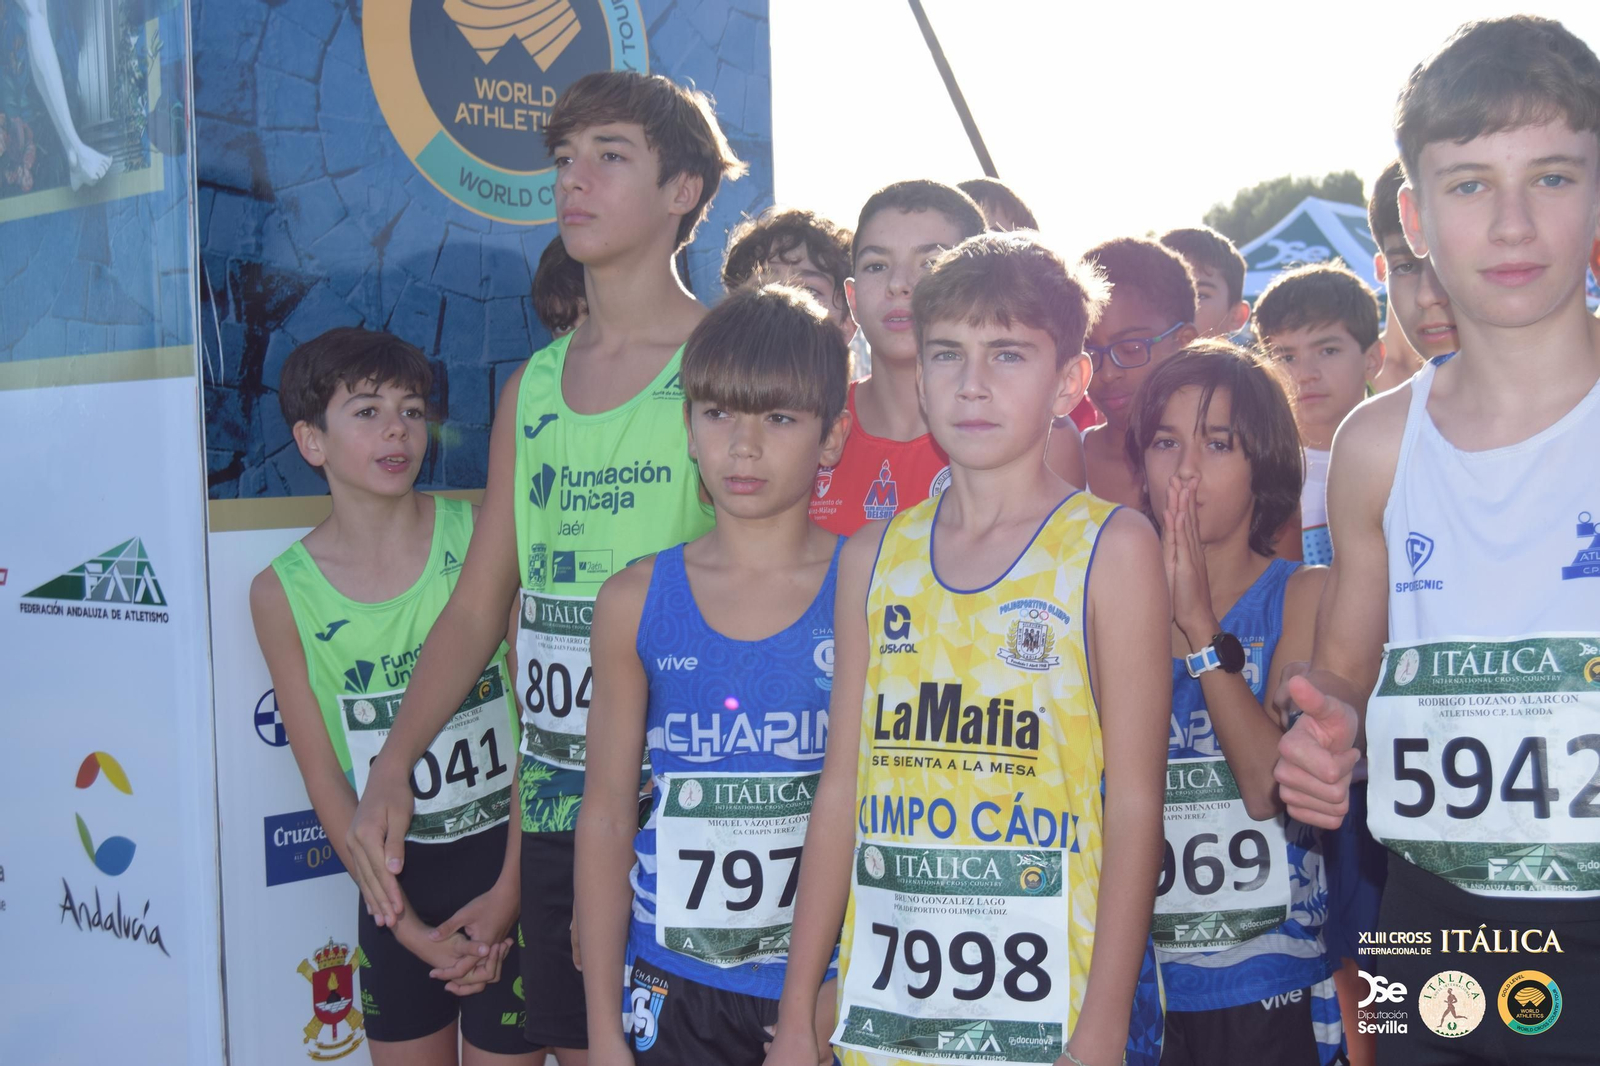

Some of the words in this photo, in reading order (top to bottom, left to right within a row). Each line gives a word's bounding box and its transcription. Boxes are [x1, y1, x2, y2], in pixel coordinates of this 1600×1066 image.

[474, 77, 557, 107] WORLD
[457, 167, 532, 208] WORLD
[560, 460, 672, 488] Fundación
[560, 486, 635, 515] Unicaja
[557, 520, 585, 536] Jaén
[20, 600, 64, 616] FEDERACIÓN
[66, 607, 109, 620] ANDALUZA
[111, 609, 122, 620] DE
[124, 610, 170, 624] ATLETISMO
[1000, 599, 1048, 615] POLIDEPORTIVO
[1048, 604, 1071, 625] OLIMPO
[656, 654, 699, 671] vive
[1432, 643, 1563, 677] ITÁLICA
[1432, 677, 1492, 685] INTERNATIONAL
[1494, 675, 1520, 683] CROSS
[1522, 674, 1562, 682] COUNTRY
[1418, 697, 1466, 707] RODRIGO
[1469, 695, 1517, 706] LOZANO
[1519, 694, 1579, 705] ALARCON
[1439, 708, 1491, 717] ATLETISMO
[1492, 708, 1509, 717] C.P.
[1511, 708, 1523, 716] LA
[1525, 707, 1553, 716] RODA
[370, 728, 507, 800] 041
[872, 756, 889, 766] SE
[893, 756, 943, 769] SIENTA
[947, 759, 957, 770] A
[963, 760, 984, 772] LA
[990, 763, 1037, 777] MESA
[1393, 733, 1600, 820] 5942
[715, 778, 813, 804] ITÁLICA
[1184, 802, 1231, 812] MENACHO
[1184, 812, 1206, 820] JEREZ
[708, 819, 743, 827] MIGUEL
[744, 814, 787, 827] VÁZQUEZ
[773, 826, 796, 834] JEREZ
[894, 851, 1002, 880] ITÁLICA
[678, 845, 804, 912] 797
[1470, 883, 1513, 891] ANDALUZA
[1528, 884, 1578, 892] ATLETISMO
[893, 904, 947, 914] POLIDEPORTIVO
[948, 907, 981, 915] OLIMPO
[982, 906, 1008, 916] CÁDIZ
[894, 893, 920, 904] BRUNO
[921, 895, 975, 906] GONZALEZ
[976, 897, 1006, 906] LAGO
[59, 876, 171, 959] Andalucía
[872, 922, 1052, 1003] 7998
[635, 968, 669, 989] CHAPIN
[1261, 989, 1304, 1011] vive
[877, 1045, 918, 1057] FEDERACIÓN
[920, 1051, 957, 1060] ANDALUZA
[970, 1054, 1007, 1062] ATLETISMO
